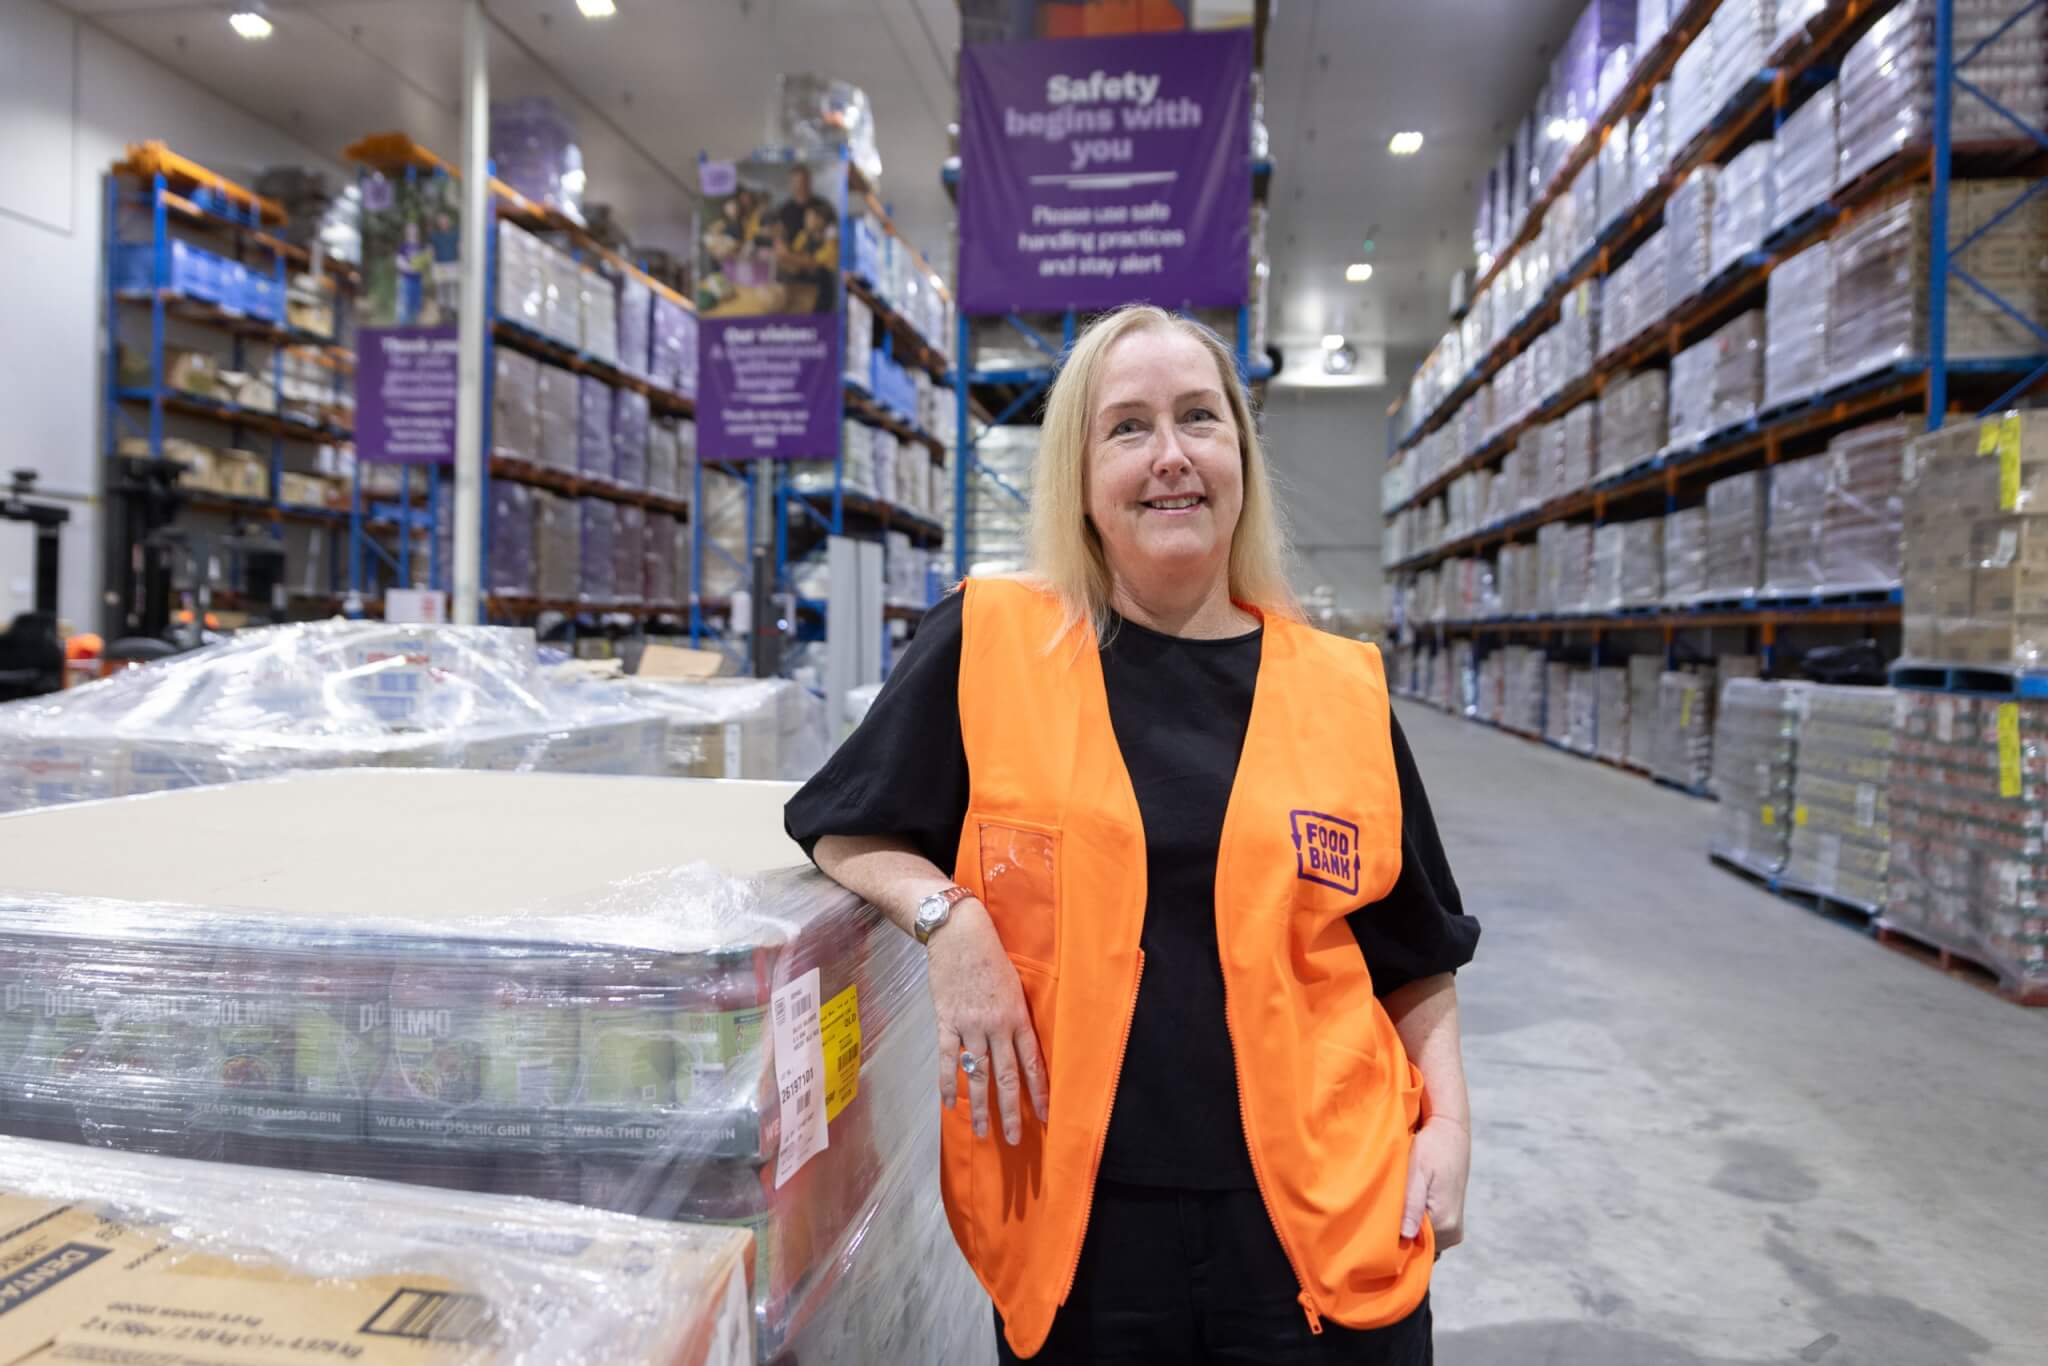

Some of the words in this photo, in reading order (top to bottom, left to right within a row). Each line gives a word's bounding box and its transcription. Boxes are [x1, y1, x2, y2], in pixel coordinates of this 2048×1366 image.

[1047, 72, 1159, 104] Safety
[1007, 105, 1113, 140] begins
[1123, 98, 1200, 129] with
[1071, 139, 1132, 169] you
[1032, 204, 1091, 226] Please
[1039, 256, 1075, 277] and
[1120, 251, 1162, 273] alert
[1306, 822, 1349, 855] FOOD
[1309, 846, 1350, 880] BANK
[376, 1115, 416, 1129] WEAR
[497, 1124, 531, 1137] GRIN
[574, 1126, 617, 1139] WEAR
[618, 1127, 643, 1139] THE
